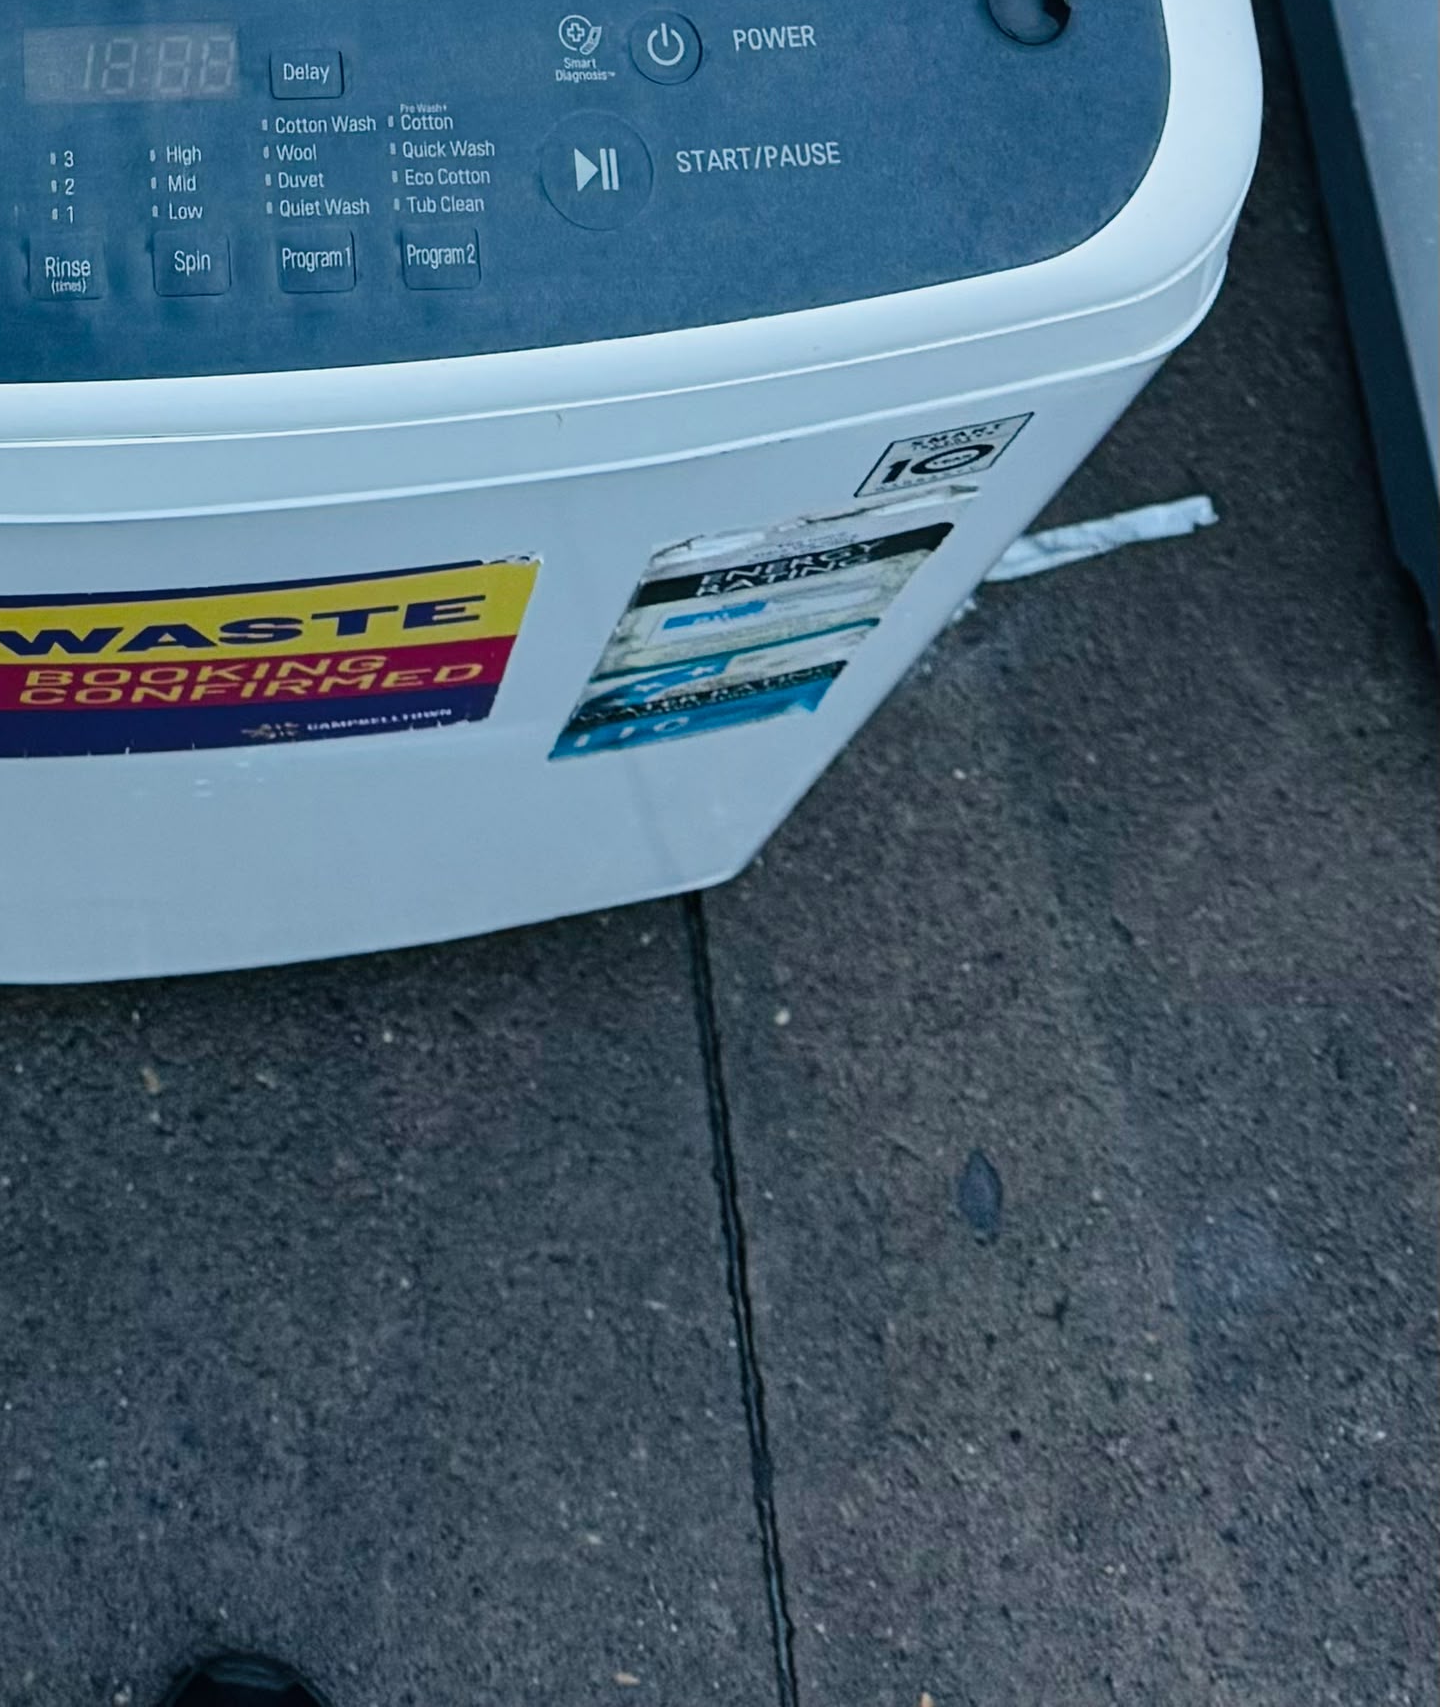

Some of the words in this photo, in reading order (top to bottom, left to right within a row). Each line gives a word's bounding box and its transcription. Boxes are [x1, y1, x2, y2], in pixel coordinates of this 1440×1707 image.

[732, 25, 817, 51] POWER
[283, 62, 330, 84] Delay
[563, 57, 597, 70] Smart
[275, 117, 327, 134] Cotton
[331, 116, 376, 132] Wash
[401, 114, 453, 131] Cotton
[166, 145, 202, 166] High
[276, 144, 317, 161] Wool
[402, 141, 446, 159] Quick
[449, 139, 495, 157] Wash
[676, 141, 841, 173] START/PAUSE
[63, 150, 74, 168] 3
[65, 178, 75, 195] 2
[168, 175, 197, 192] Mid
[278, 171, 324, 188] Duvet
[405, 169, 433, 186] Eco
[437, 168, 490, 185] Cotton
[169, 203, 203, 220] Low
[279, 199, 320, 218] Quiet
[324, 198, 370, 215] Wash
[406, 196, 436, 214] Tub
[440, 195, 484, 212] Clean
[66, 206, 74, 223] 1
[174, 250, 211, 276] Spin
[282, 247, 342, 273] Program
[344, 248, 351, 267] 1
[406, 243, 464, 269] Program
[467, 243, 476, 264] 2
[45, 256, 91, 278] Rinse
[51, 279, 87, 294] (times)
[24, 655, 388, 687] BOOKING
[19, 662, 484, 706] CONFIRMED
